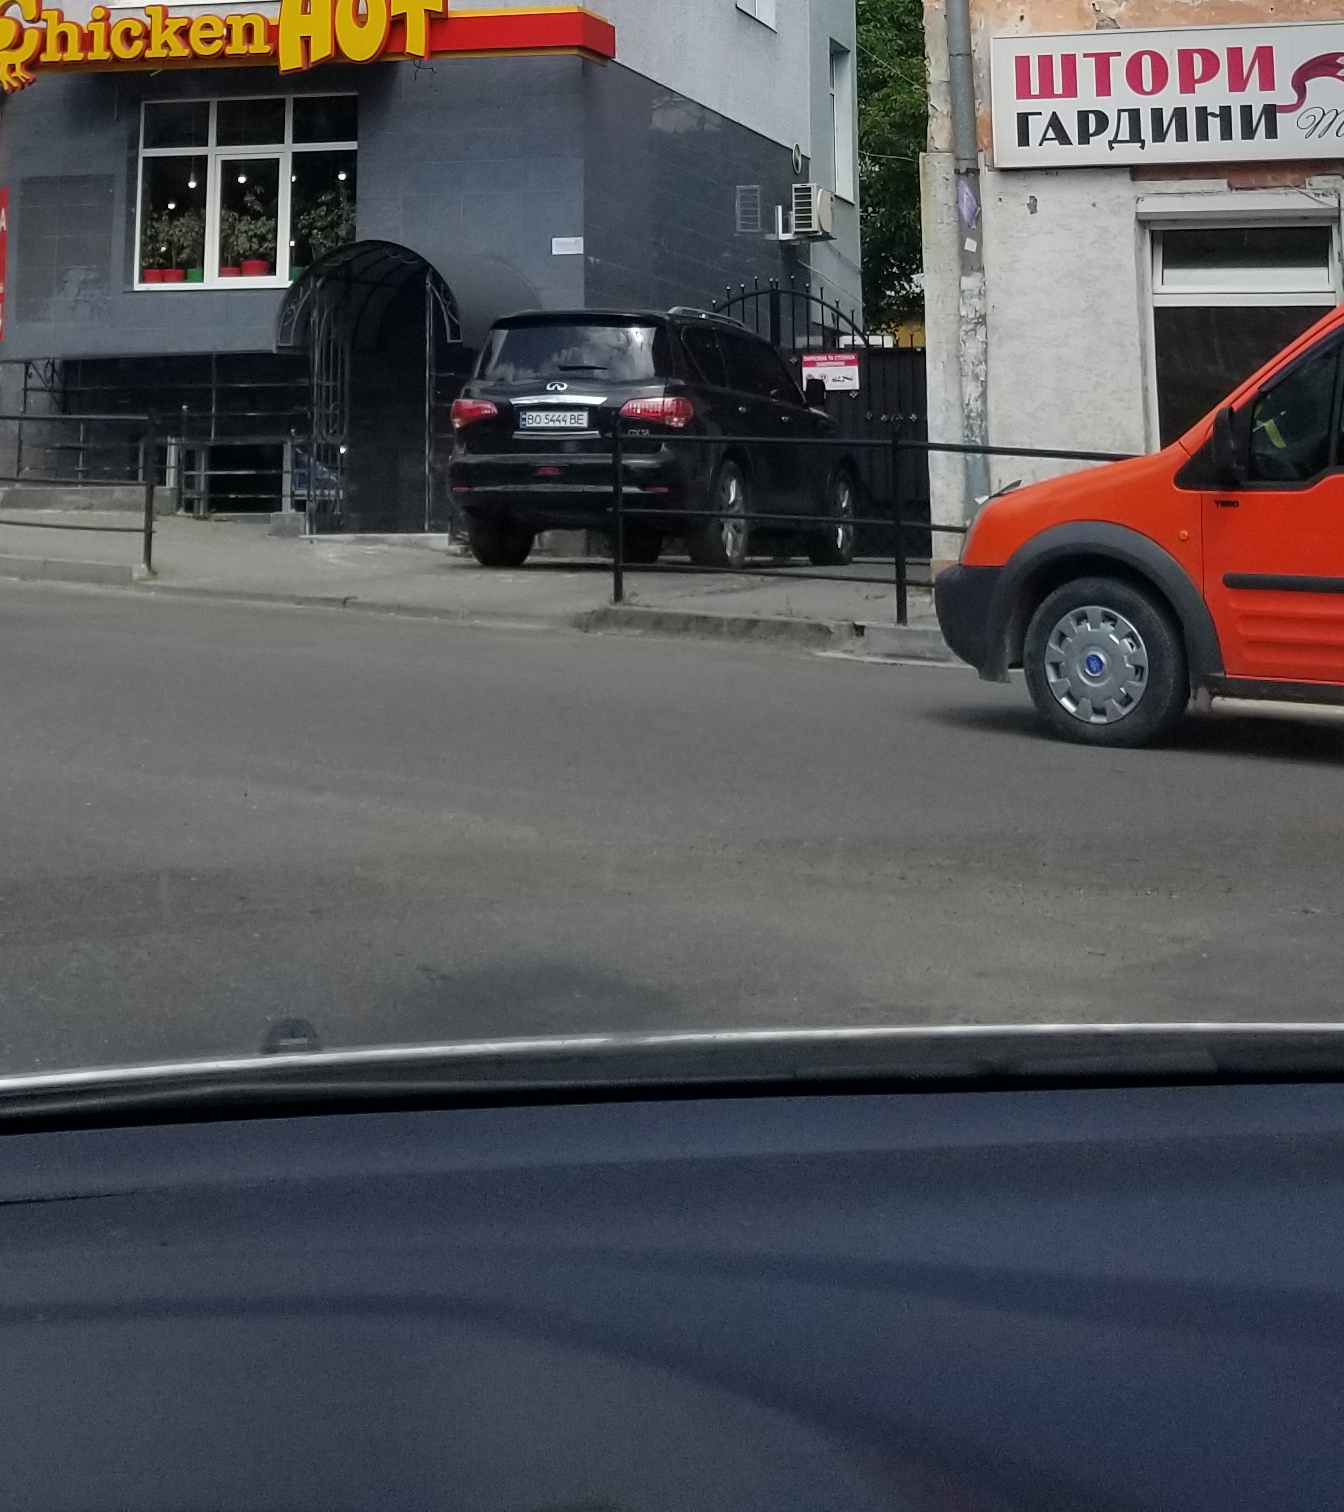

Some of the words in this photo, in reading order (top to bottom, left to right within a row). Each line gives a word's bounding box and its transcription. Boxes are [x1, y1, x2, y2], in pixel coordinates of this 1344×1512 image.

[1014, 45, 1277, 101] ШТОРИ
[1015, 102, 1278, 151] ГАРДИНИ
[527, 414, 542, 425] BO
[544, 414, 567, 425] 5444
[569, 414, 584, 425] BE
